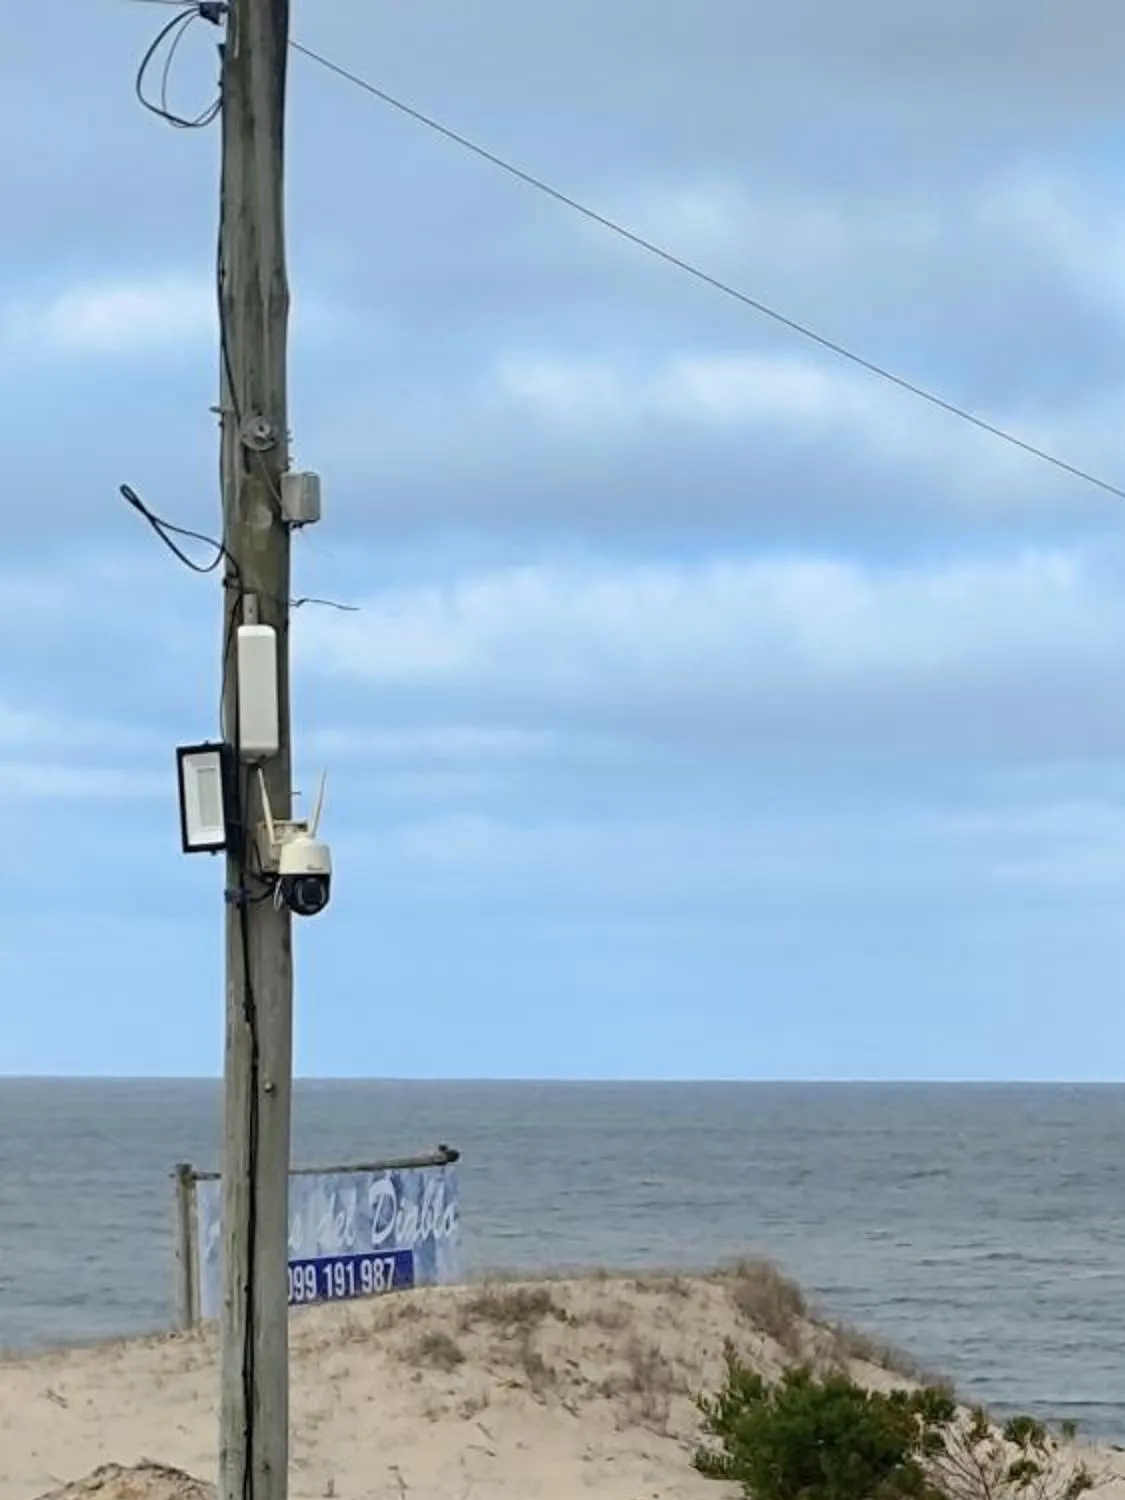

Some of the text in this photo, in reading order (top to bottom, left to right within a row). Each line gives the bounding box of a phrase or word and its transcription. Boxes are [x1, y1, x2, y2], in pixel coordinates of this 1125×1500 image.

[368, 1173, 457, 1244] Diablo
[322, 1260, 355, 1297] 191
[360, 1256, 395, 1294] 987
